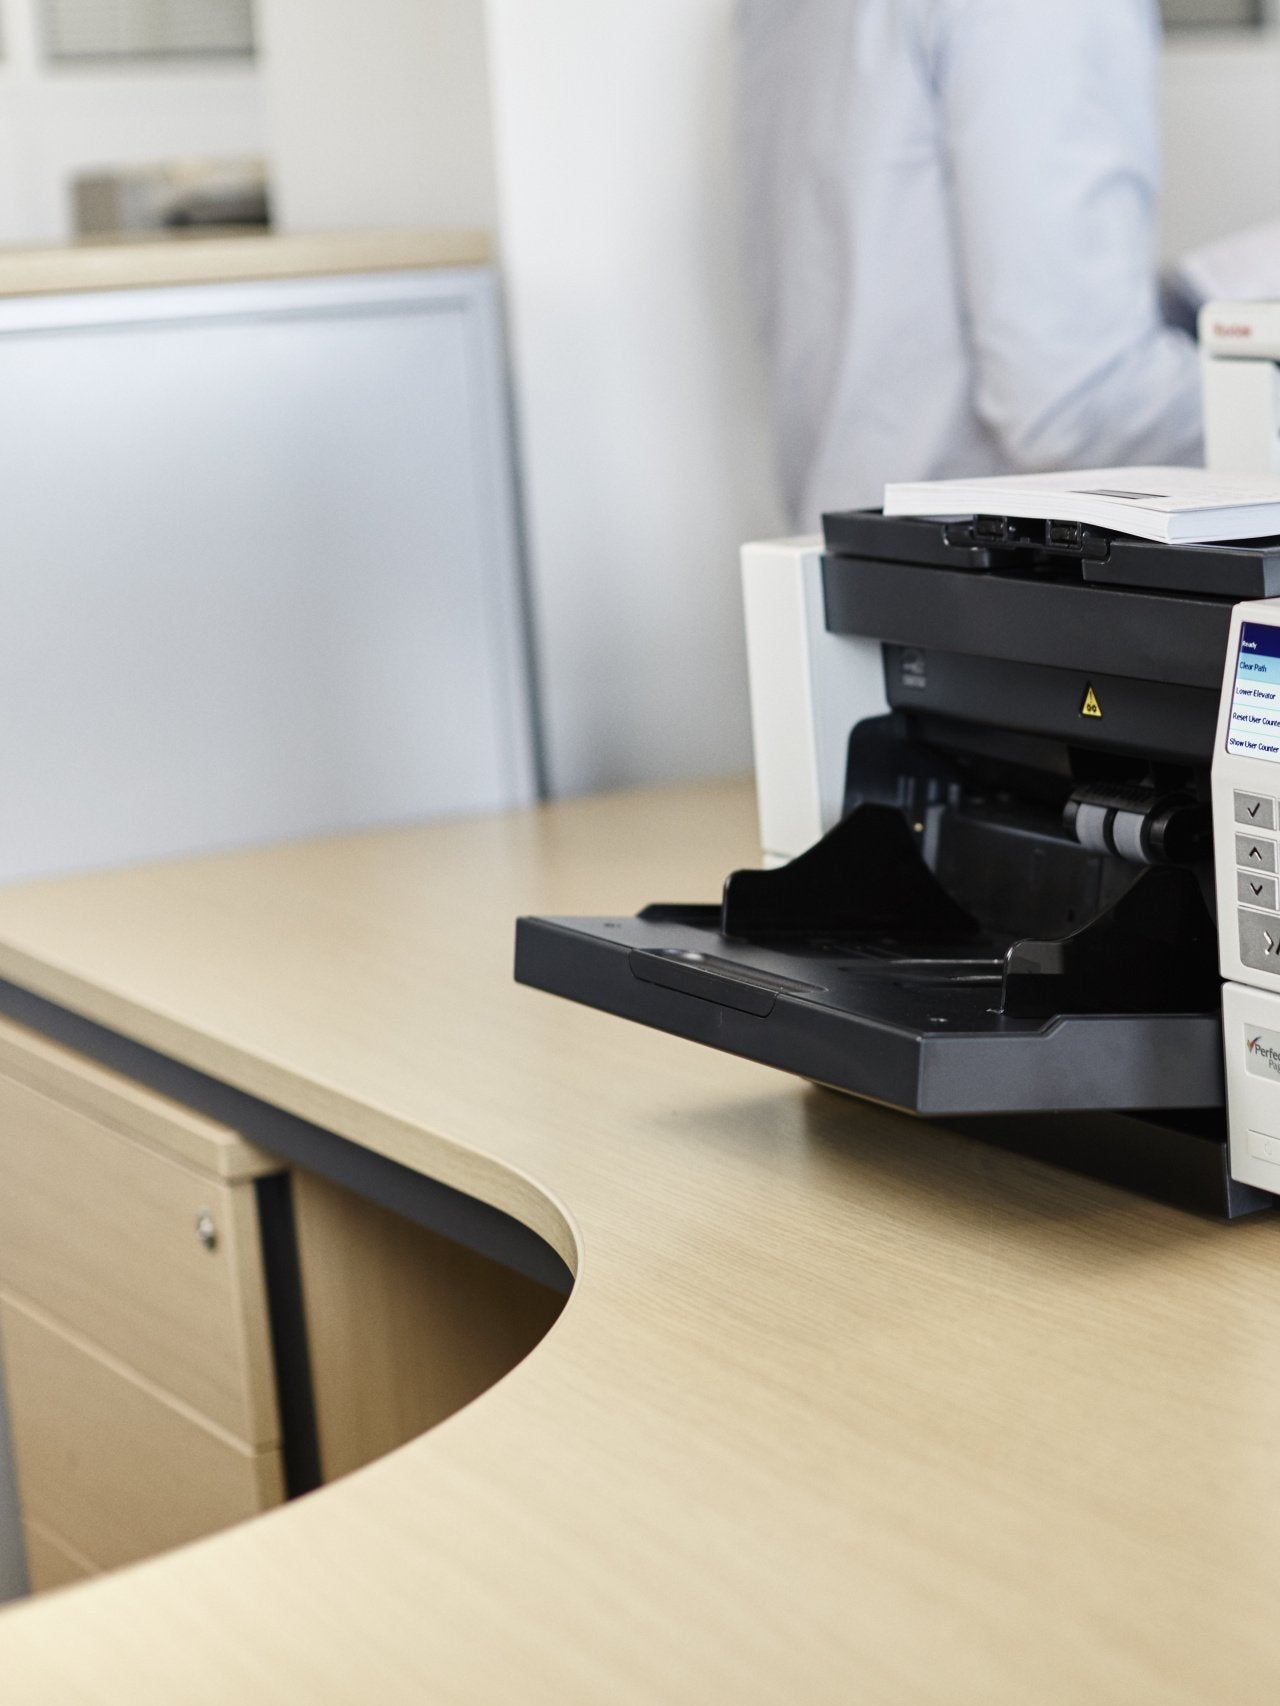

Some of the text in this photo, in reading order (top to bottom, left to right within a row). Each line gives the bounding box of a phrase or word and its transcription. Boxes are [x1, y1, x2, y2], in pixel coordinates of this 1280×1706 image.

[1239, 661, 1267, 673] Clear Path
[1236, 687, 1276, 700] Lower Elevator
[1232, 712, 1248, 722] Reset
[1248, 714, 1262, 724] User
[1229, 738, 1280, 753] Show User Counter
